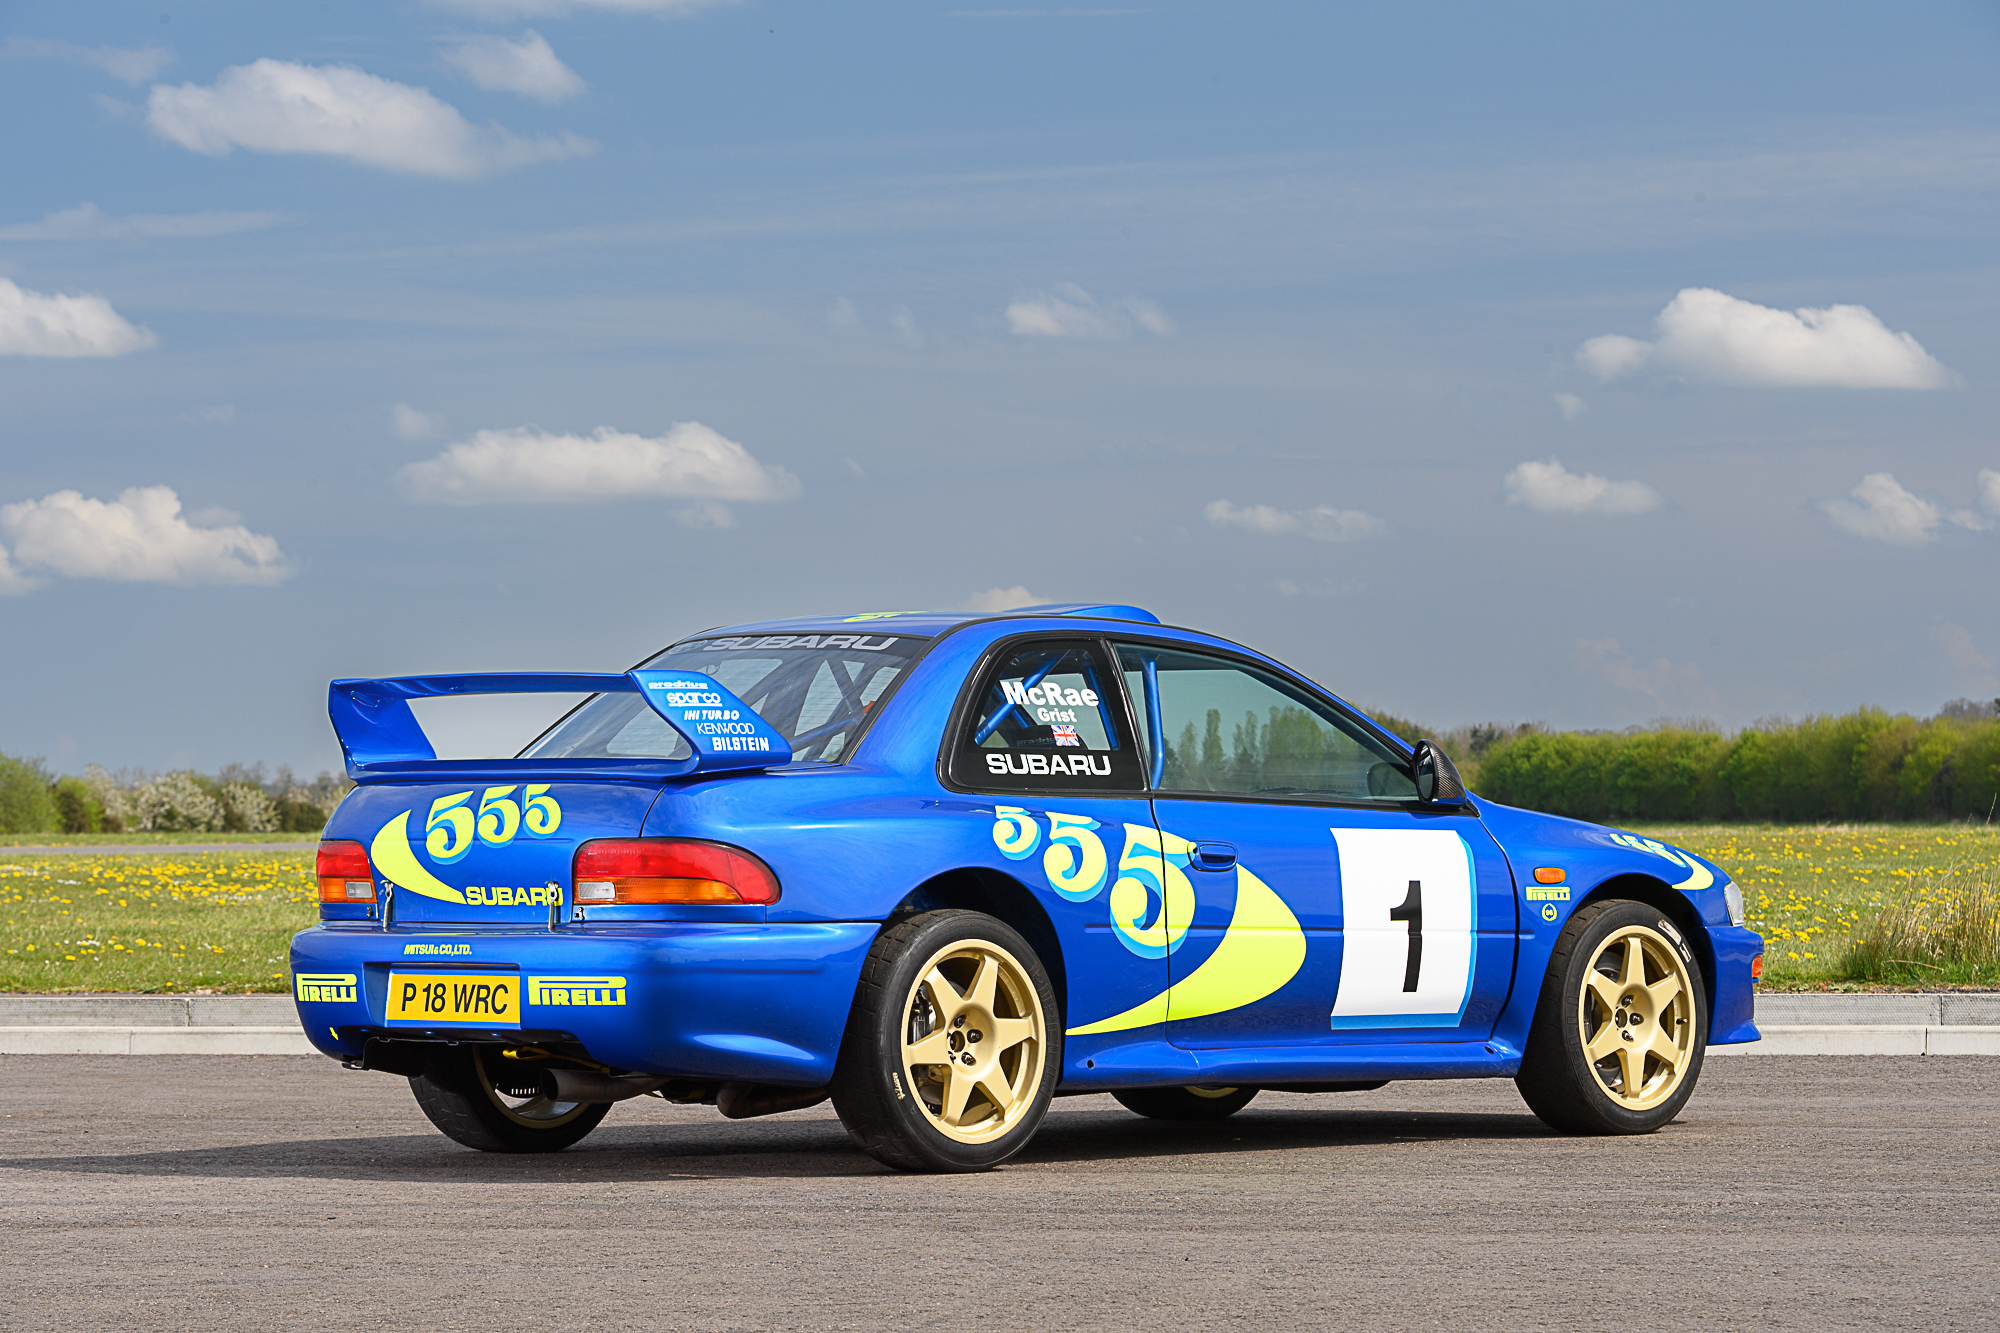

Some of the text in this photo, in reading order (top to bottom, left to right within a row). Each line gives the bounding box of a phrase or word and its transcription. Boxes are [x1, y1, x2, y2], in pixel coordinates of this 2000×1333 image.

[703, 635, 899, 651] SUBARU
[666, 692, 723, 707] sparco
[1000, 681, 1100, 707] McRae
[702, 710, 740, 720] TURBO
[1037, 707, 1077, 722] Grist
[696, 723, 755, 734] KENWOOD
[712, 737, 770, 751] BILSTEIN
[985, 753, 1112, 776] SUBARU
[425, 784, 562, 865] 555
[992, 805, 1197, 960] 555
[465, 886, 564, 906] SUBARU
[1526, 886, 1571, 901] PIRELLI
[1390, 880, 1423, 992] 1
[295, 973, 358, 1003] PIRELLI
[527, 975, 627, 1006] PIRELLI
[453, 983, 509, 1015] WRC
